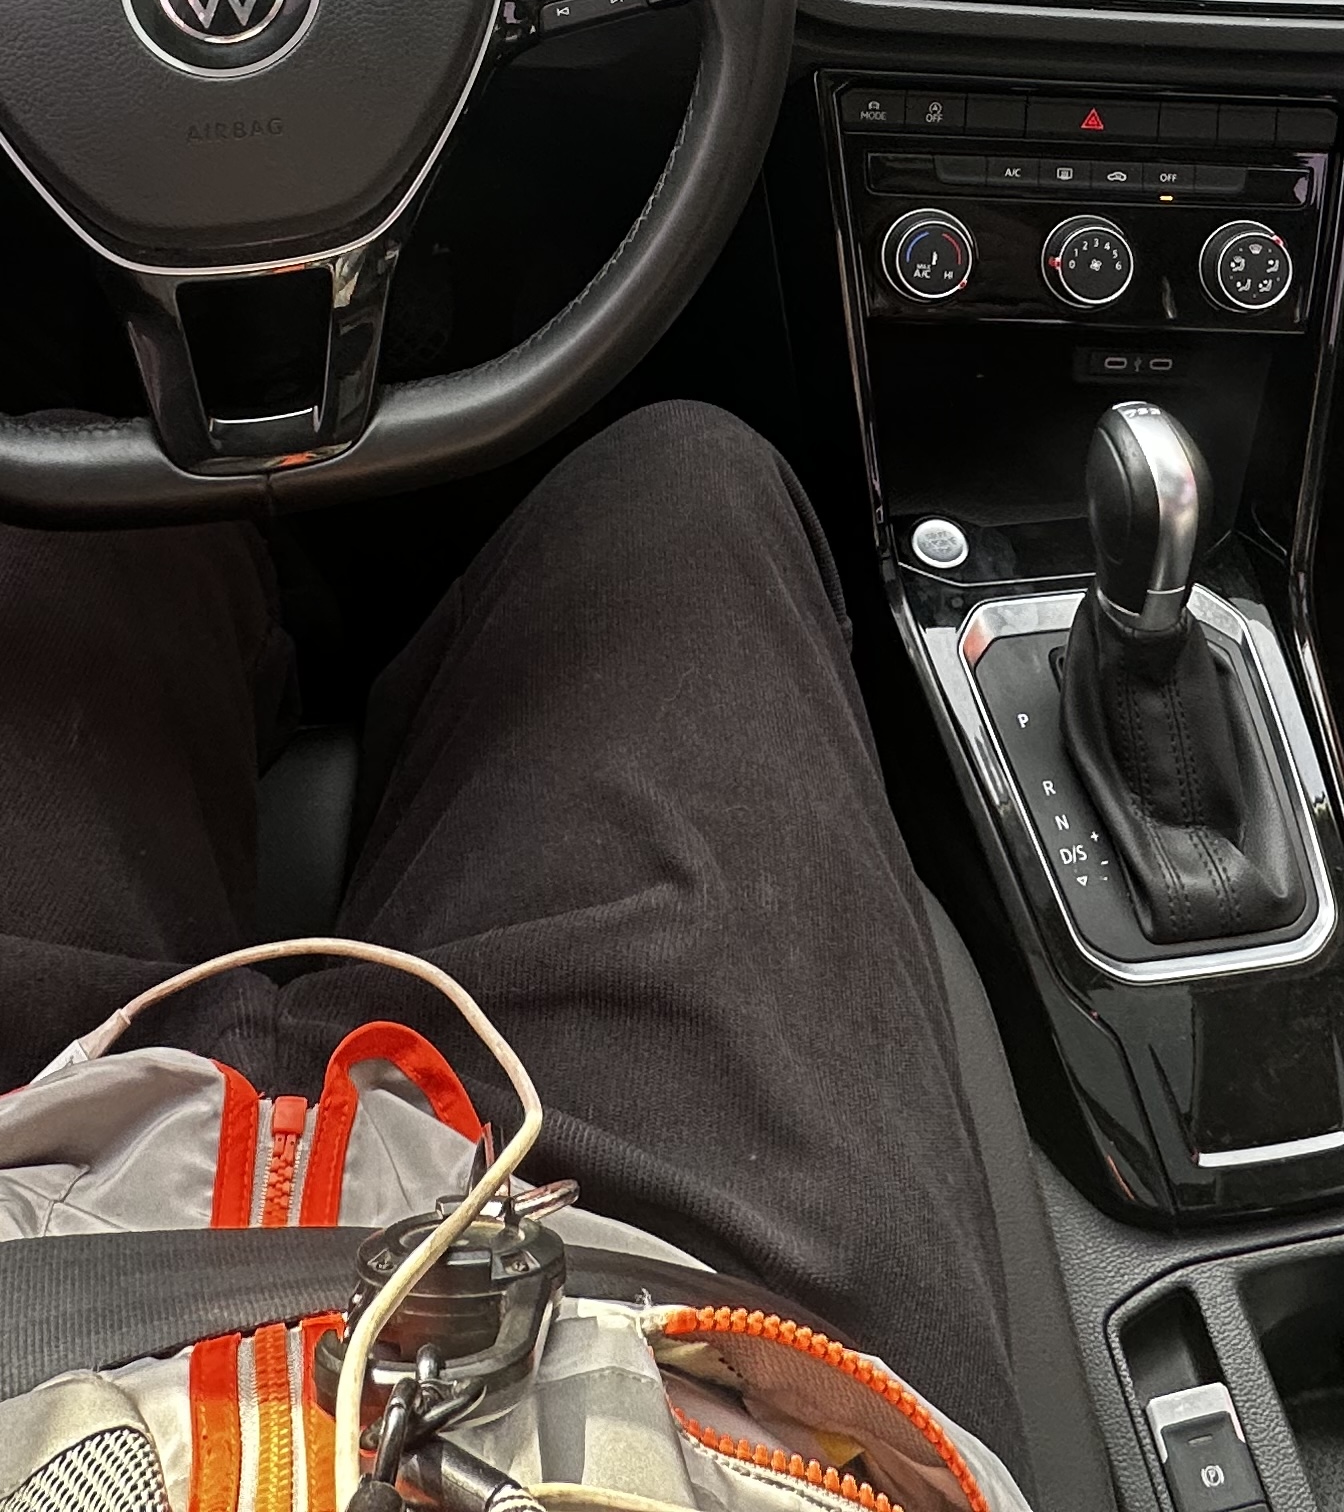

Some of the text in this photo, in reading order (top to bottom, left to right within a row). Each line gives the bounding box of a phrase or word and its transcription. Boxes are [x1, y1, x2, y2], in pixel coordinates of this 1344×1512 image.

[860, 111, 887, 121] MODE
[925, 113, 943, 123] OFF
[186, 117, 284, 144] AIRBAG
[1004, 167, 1021, 178] A/C
[1159, 172, 1178, 184] OFF
[1082, 241, 1089, 251] 2
[1093, 238, 1100, 248] 3
[1104, 241, 1111, 251] 4
[1112, 249, 1119, 259] 5
[1068, 259, 1076, 269] 0
[1115, 261, 1123, 270] 6
[943, 271, 954, 280] HI
[1017, 713, 1029, 729] P
[1042, 780, 1057, 796] R
[1055, 814, 1070, 831] N
[1060, 844, 1088, 865] D/S
